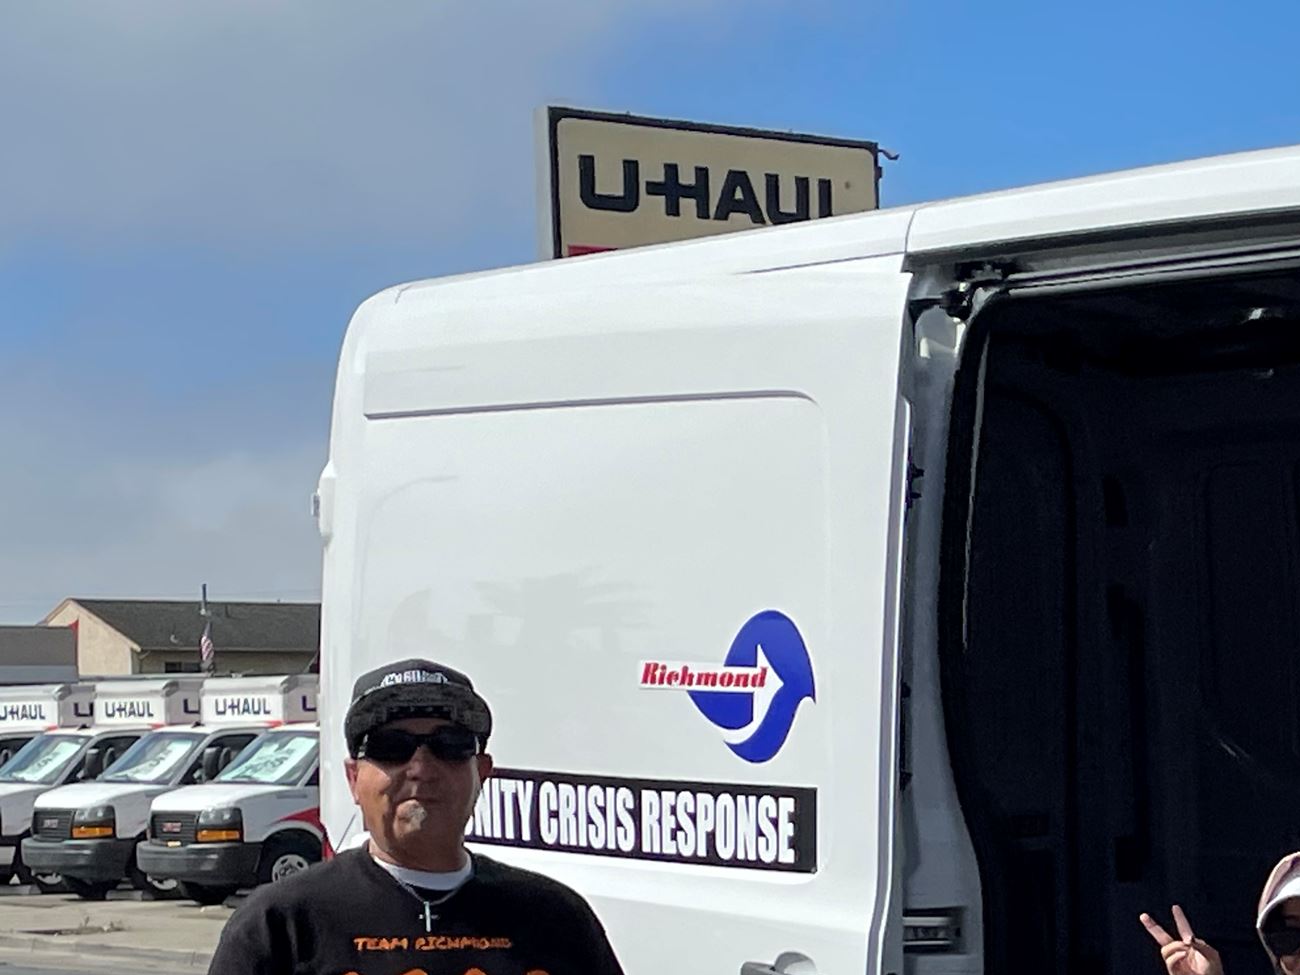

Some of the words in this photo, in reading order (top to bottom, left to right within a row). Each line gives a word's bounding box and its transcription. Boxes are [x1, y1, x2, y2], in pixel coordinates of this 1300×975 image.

[640, 662, 768, 689] Richmond
[105, 701, 154, 717] U-HAUL
[215, 698, 271, 715] U-HAUL
[538, 780, 635, 854] CRISIS
[641, 790, 796, 865] RESPONSE
[353, 936, 409, 951] TEAM
